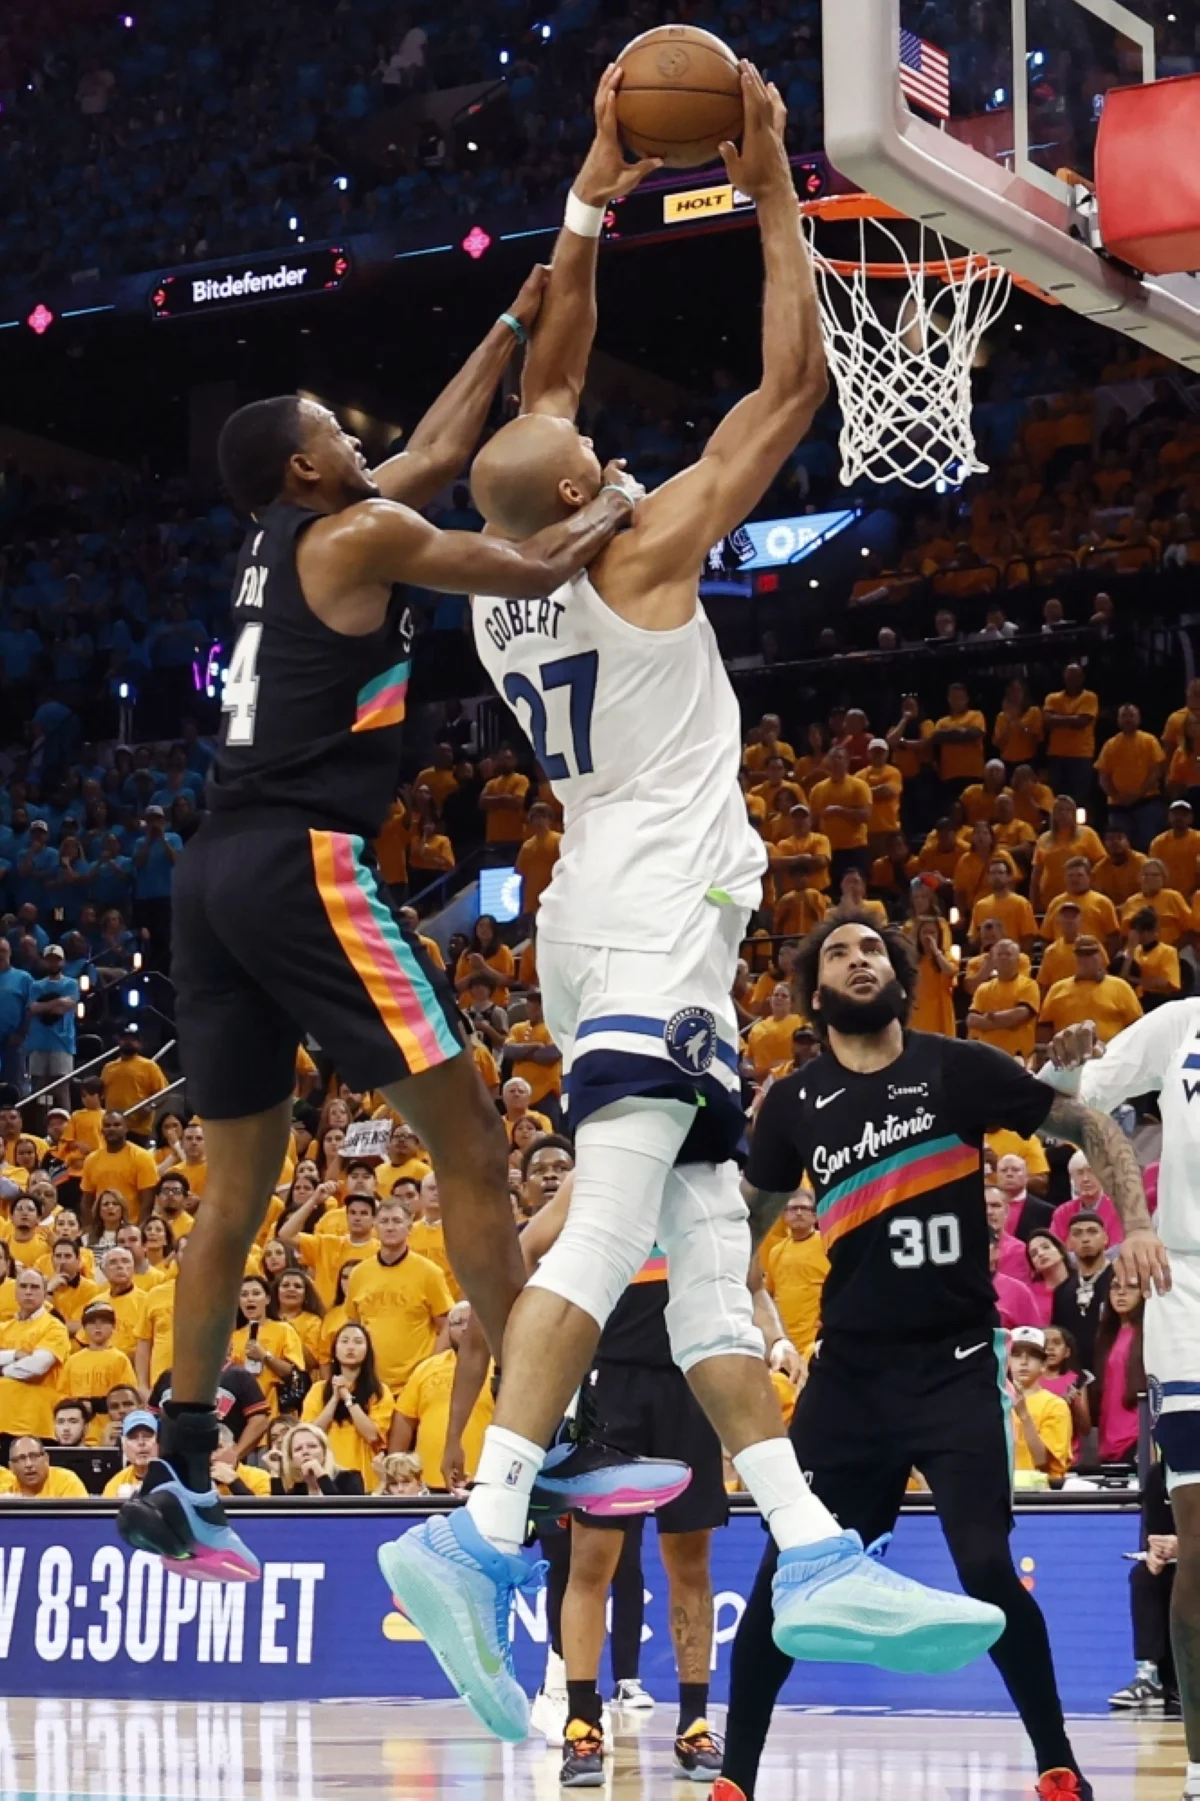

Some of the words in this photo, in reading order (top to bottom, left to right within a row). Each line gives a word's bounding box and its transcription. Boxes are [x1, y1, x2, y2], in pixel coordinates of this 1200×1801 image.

[676, 194, 726, 212] HOLT
[192, 264, 307, 303] Bitdefender
[235, 565, 269, 608] FOX
[485, 599, 565, 651] GOBERT
[221, 621, 264, 746] 4
[503, 649, 599, 781] 27
[812, 1145, 851, 1184] San
[853, 1106, 936, 1160] Antonio
[888, 1213, 962, 1269] 30
[35, 1545, 246, 1663] 8:30PM
[259, 1562, 325, 1664] ET
